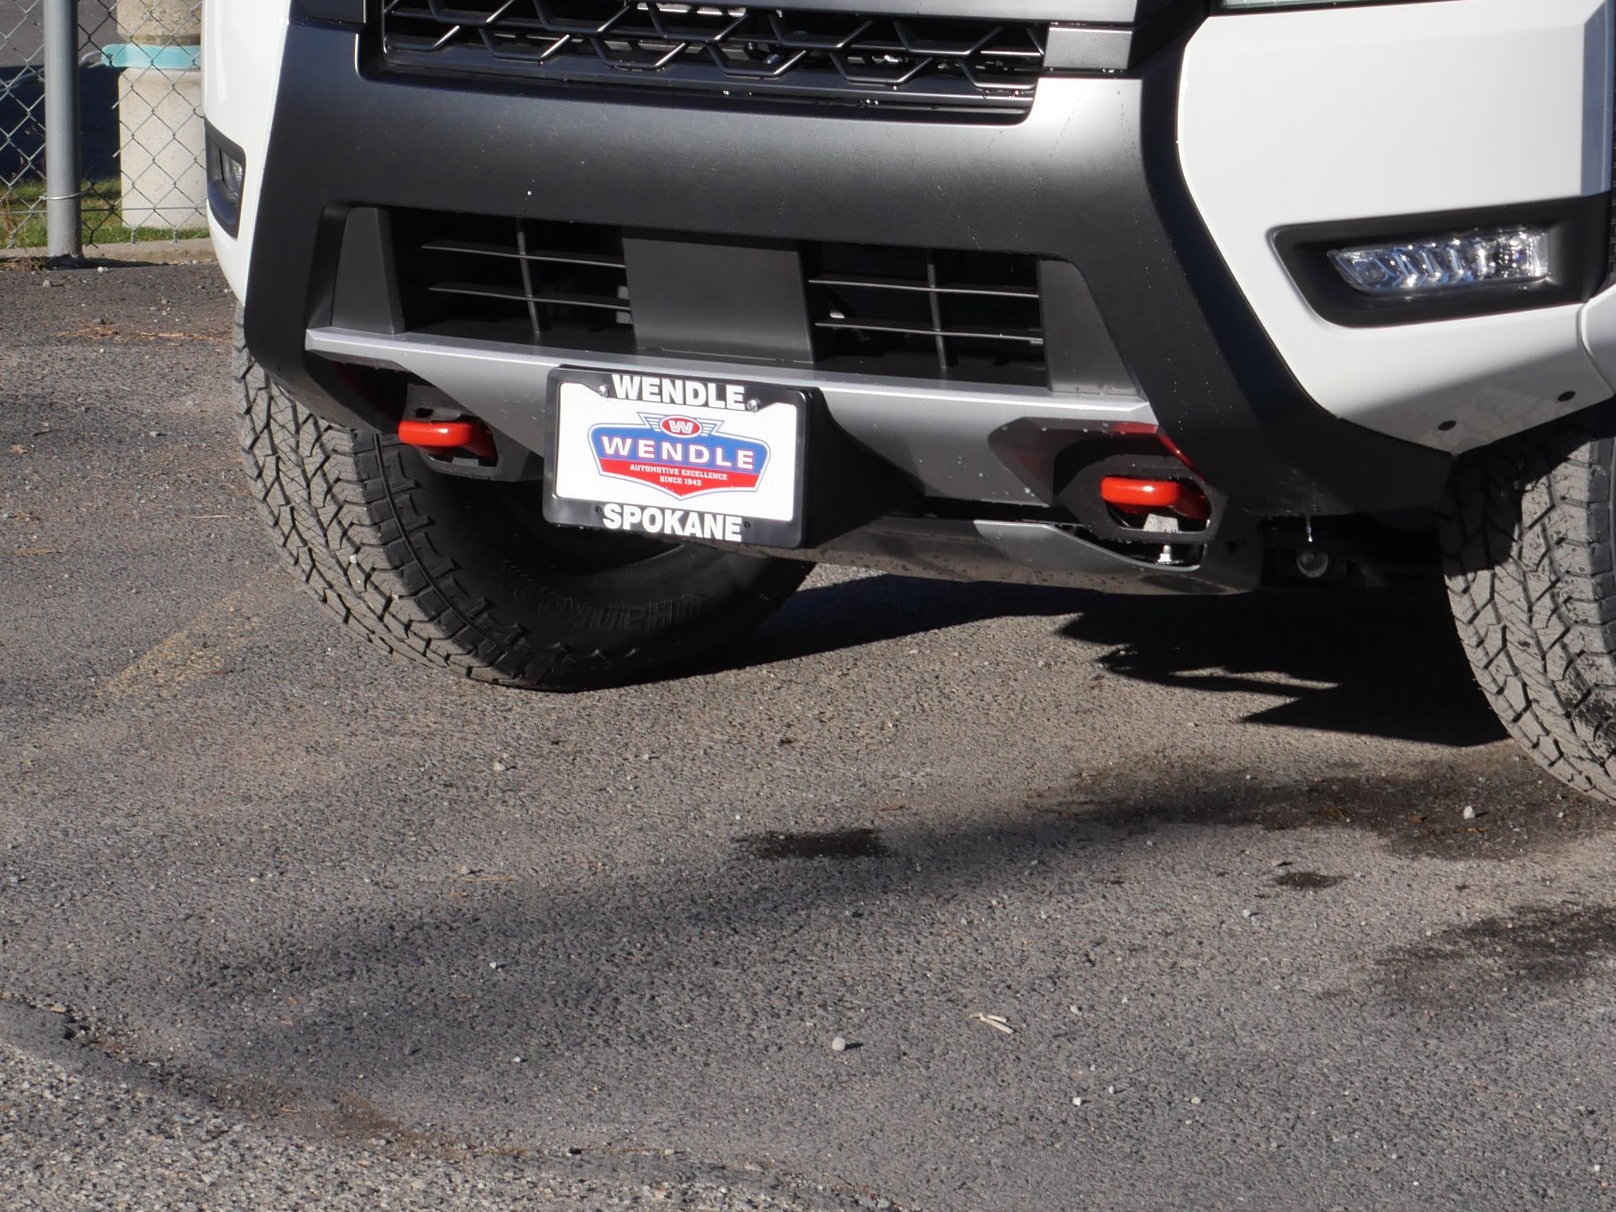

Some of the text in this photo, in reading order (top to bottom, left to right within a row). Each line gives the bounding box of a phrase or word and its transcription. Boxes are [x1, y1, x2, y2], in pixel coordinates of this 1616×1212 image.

[611, 374, 746, 411] WENDLE
[602, 435, 755, 470] WENDLE
[629, 464, 728, 481] AUTOMOTIVE EXCELLENCE
[659, 475, 702, 487] SINCE 1943
[603, 502, 743, 542] SPOKANE
